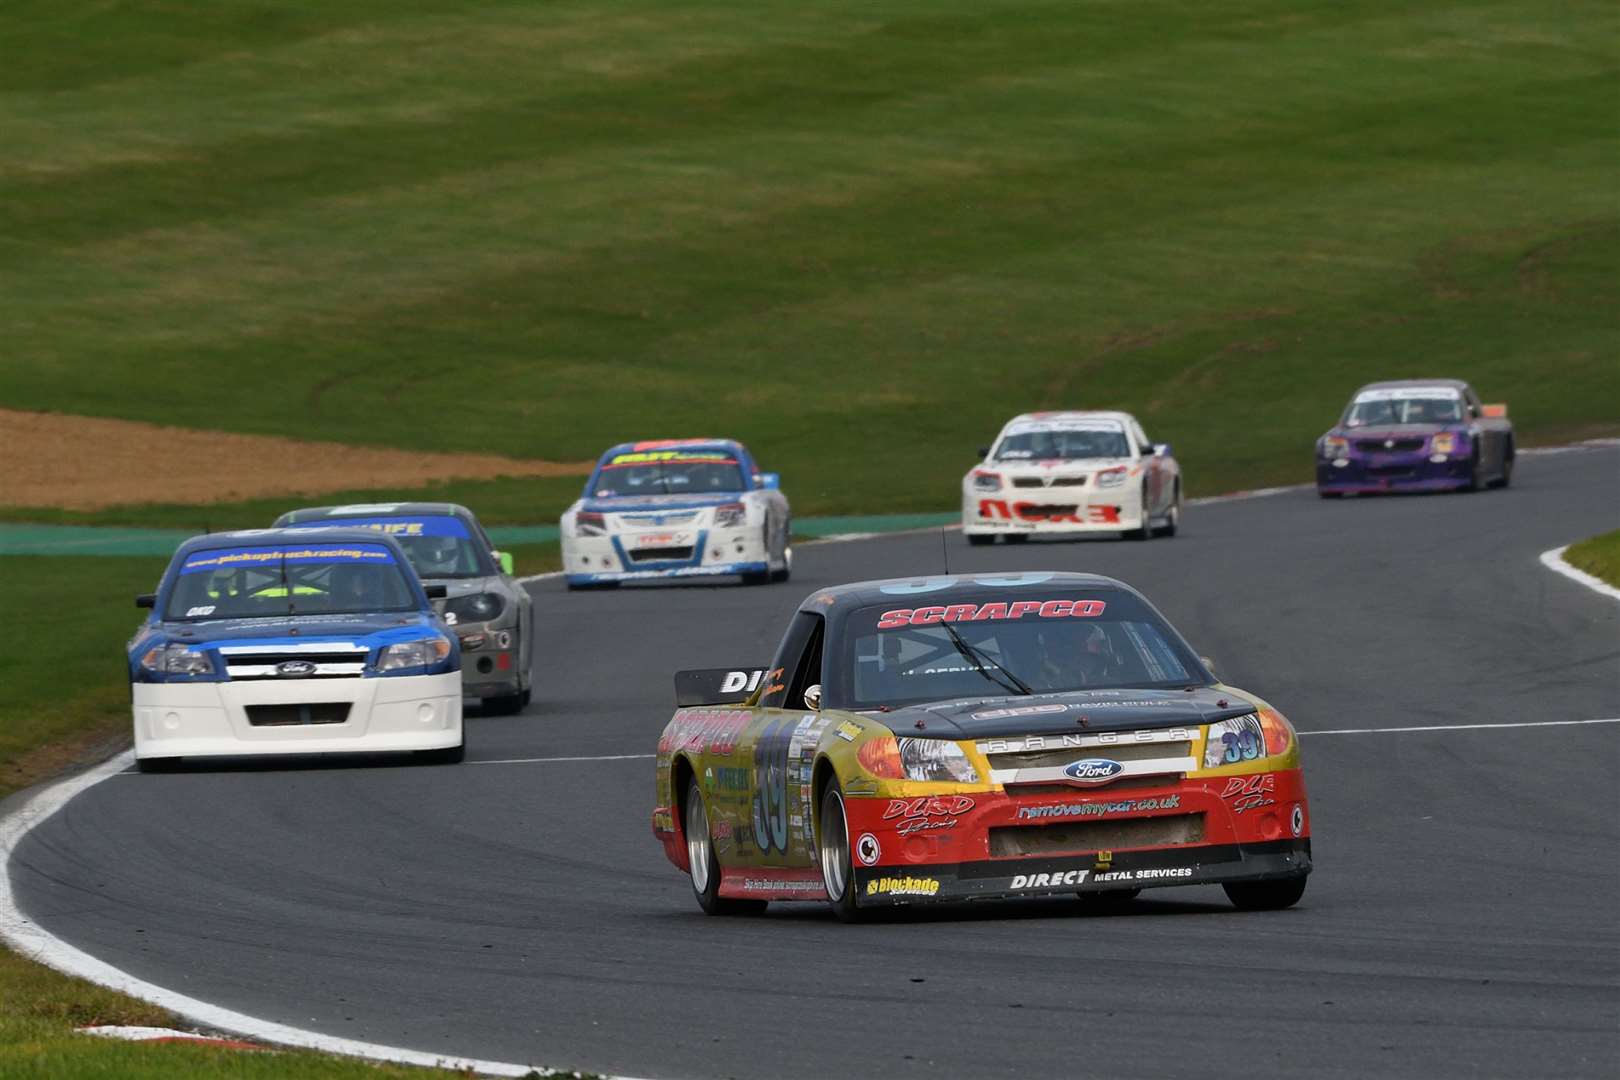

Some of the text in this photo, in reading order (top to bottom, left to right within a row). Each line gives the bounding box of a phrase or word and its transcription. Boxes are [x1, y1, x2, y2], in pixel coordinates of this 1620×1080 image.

[877, 600, 1106, 629] SCRAPCO
[719, 670, 769, 693] DI
[987, 728, 1192, 752] RANGER
[1221, 730, 1258, 763] 39
[1075, 761, 1114, 778] Ford
[1017, 794, 1180, 819] removemycar.co.uk
[878, 876, 940, 892] Blockade
[1009, 868, 1193, 889] DIRECT METAL SERVICES
